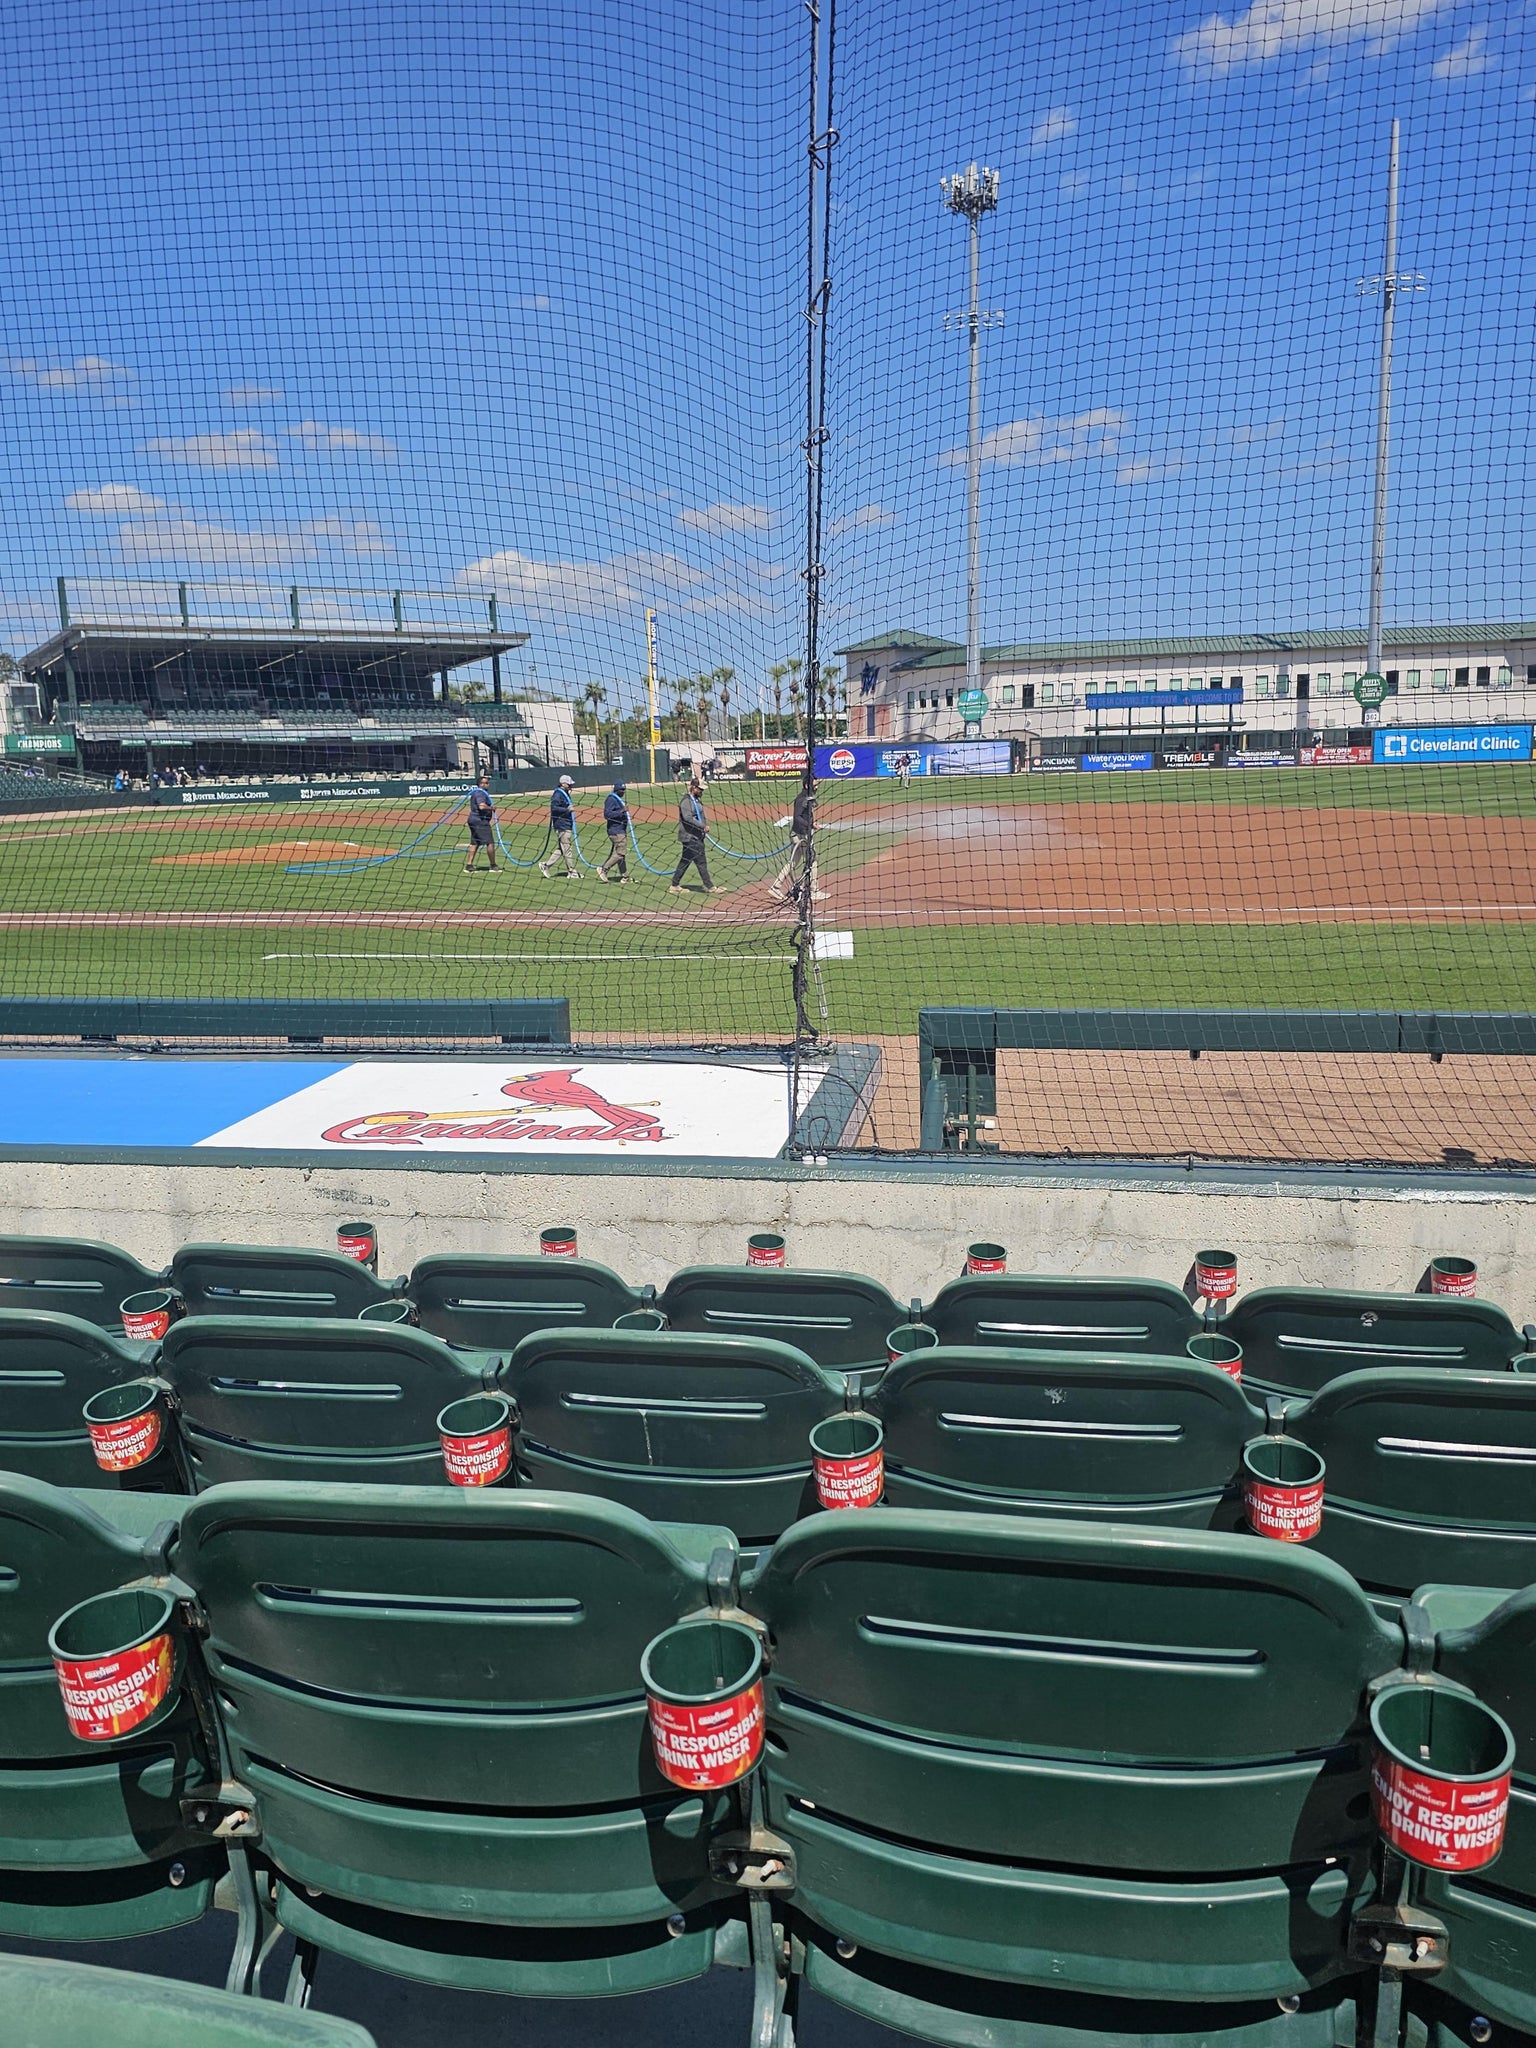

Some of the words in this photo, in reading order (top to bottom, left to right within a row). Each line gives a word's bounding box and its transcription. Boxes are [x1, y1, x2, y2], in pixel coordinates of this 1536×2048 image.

[1410, 737, 1478, 752] Cleveland
[1481, 736, 1520, 750] Clinic
[749, 751, 783, 764] Roger
[781, 751, 807, 762] Dean
[1113, 755, 1128, 763] you
[1163, 752, 1215, 762] TREMBLE
[321, 1111, 672, 1145] Cardinals
[116, 1441, 146, 1459] WISER
[469, 1458, 499, 1475] WISER
[821, 1486, 849, 1500] DRINK
[850, 1480, 878, 1499] WISER
[1261, 1513, 1295, 1529] DRINK
[66, 1658, 160, 1705] RESPONSIBLY.
[93, 1688, 147, 1720] WISER
[657, 1741, 700, 1770] DRINK
[701, 1736, 750, 1769] WISER
[1374, 1774, 1413, 1815] ENJOY
[1398, 1780, 1447, 1808] Budweiser
[1391, 1809, 1449, 1848] DRINK
[1454, 1822, 1502, 1850] WISER
